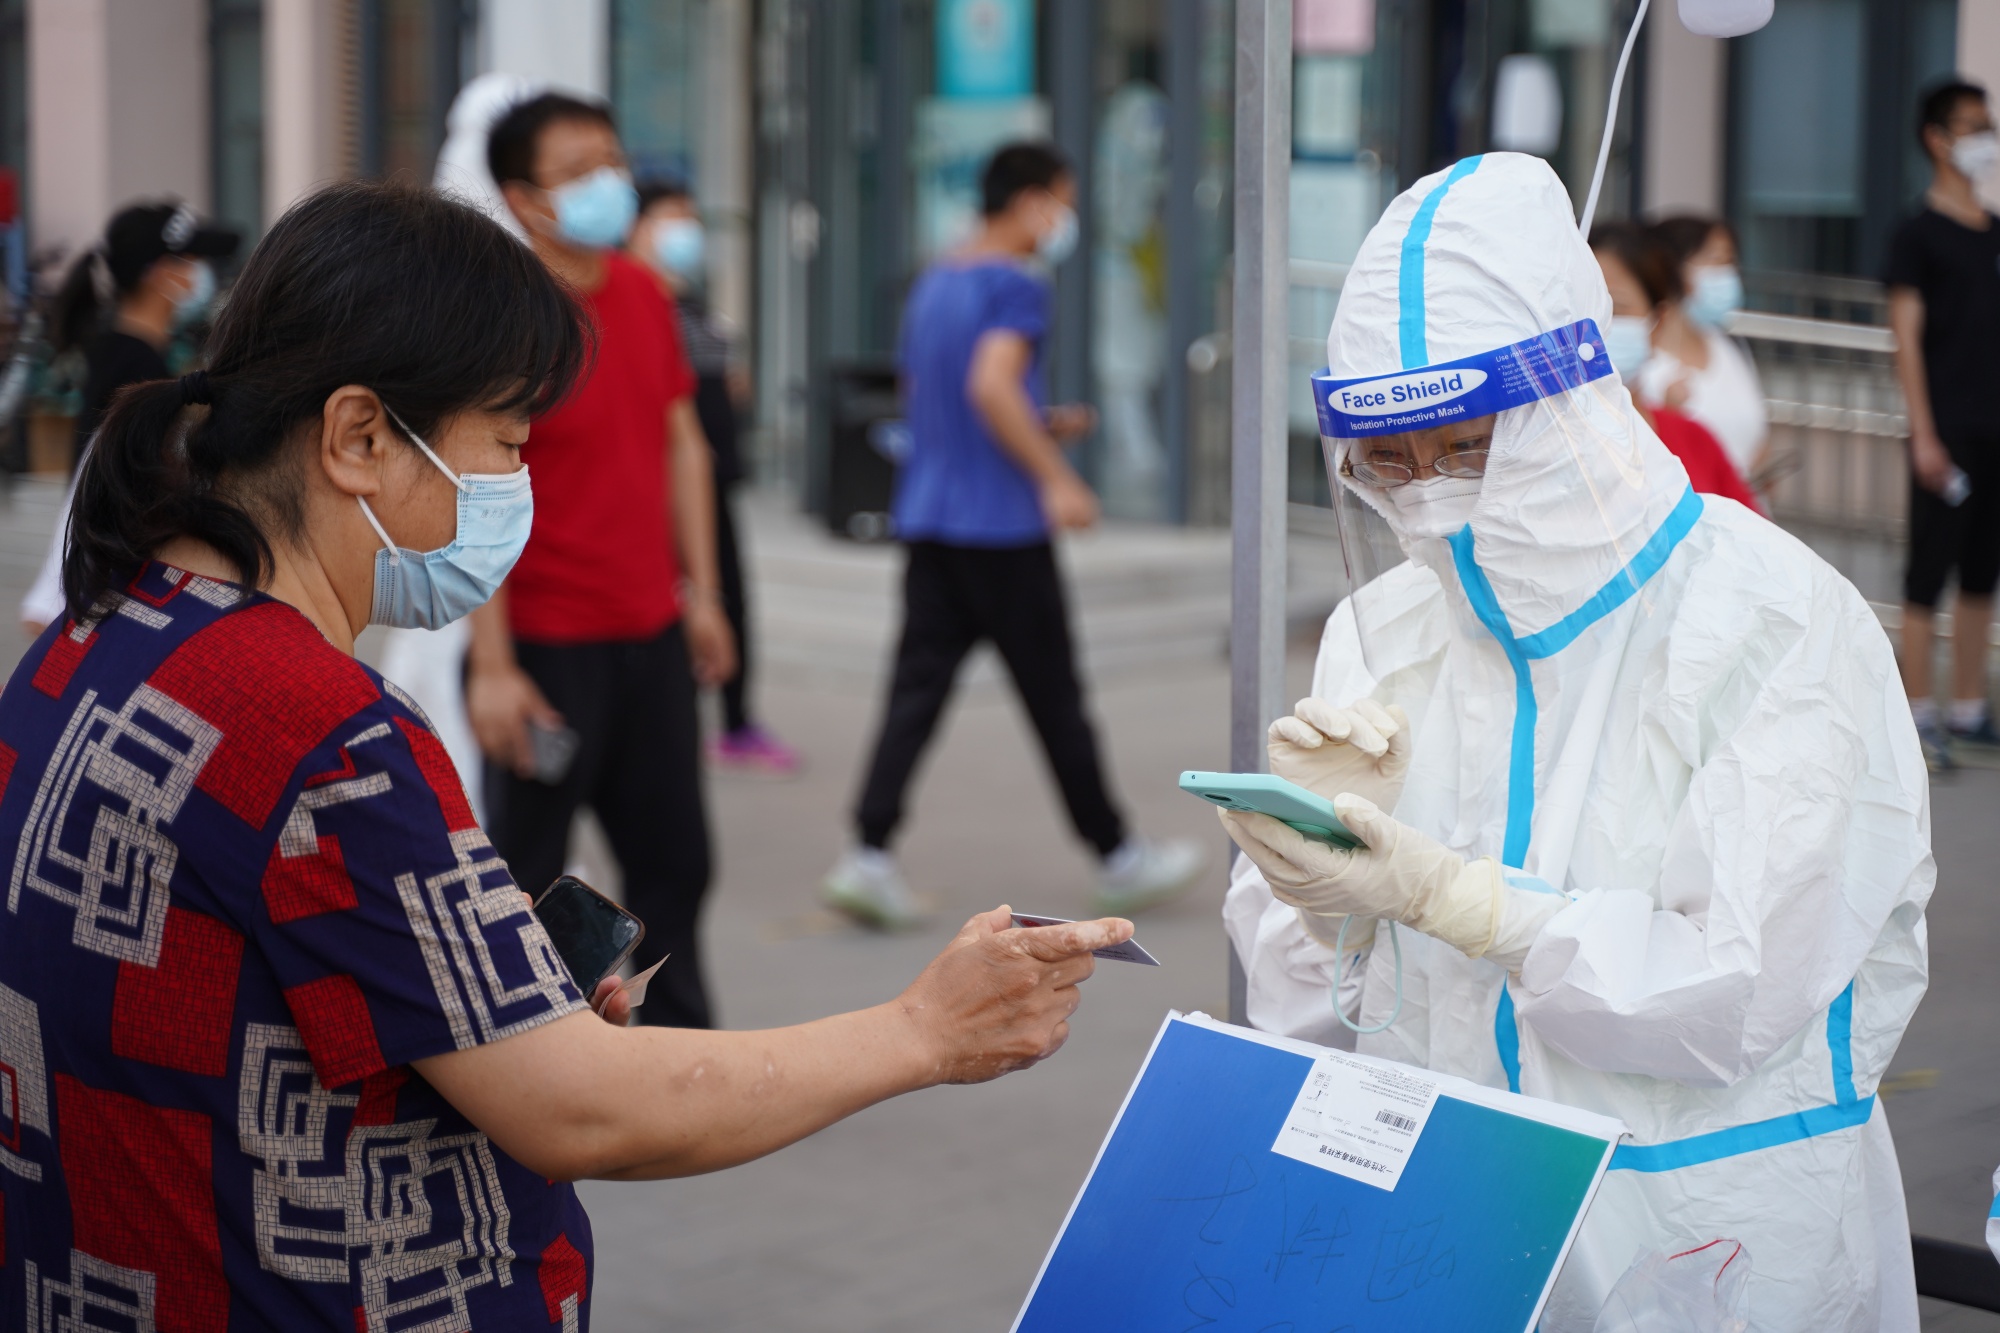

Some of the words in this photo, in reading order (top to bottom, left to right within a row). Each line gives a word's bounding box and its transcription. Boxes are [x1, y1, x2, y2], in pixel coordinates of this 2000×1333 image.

[1341, 392, 1386, 409] Face
[1391, 373, 1464, 403] Shield
[1350, 421, 1385, 431] Isolation
[1386, 411, 1436, 427] Protective
[1437, 404, 1466, 418] Mask
[1319, 1144, 1394, 1174] 一次性使用病毒采样管
